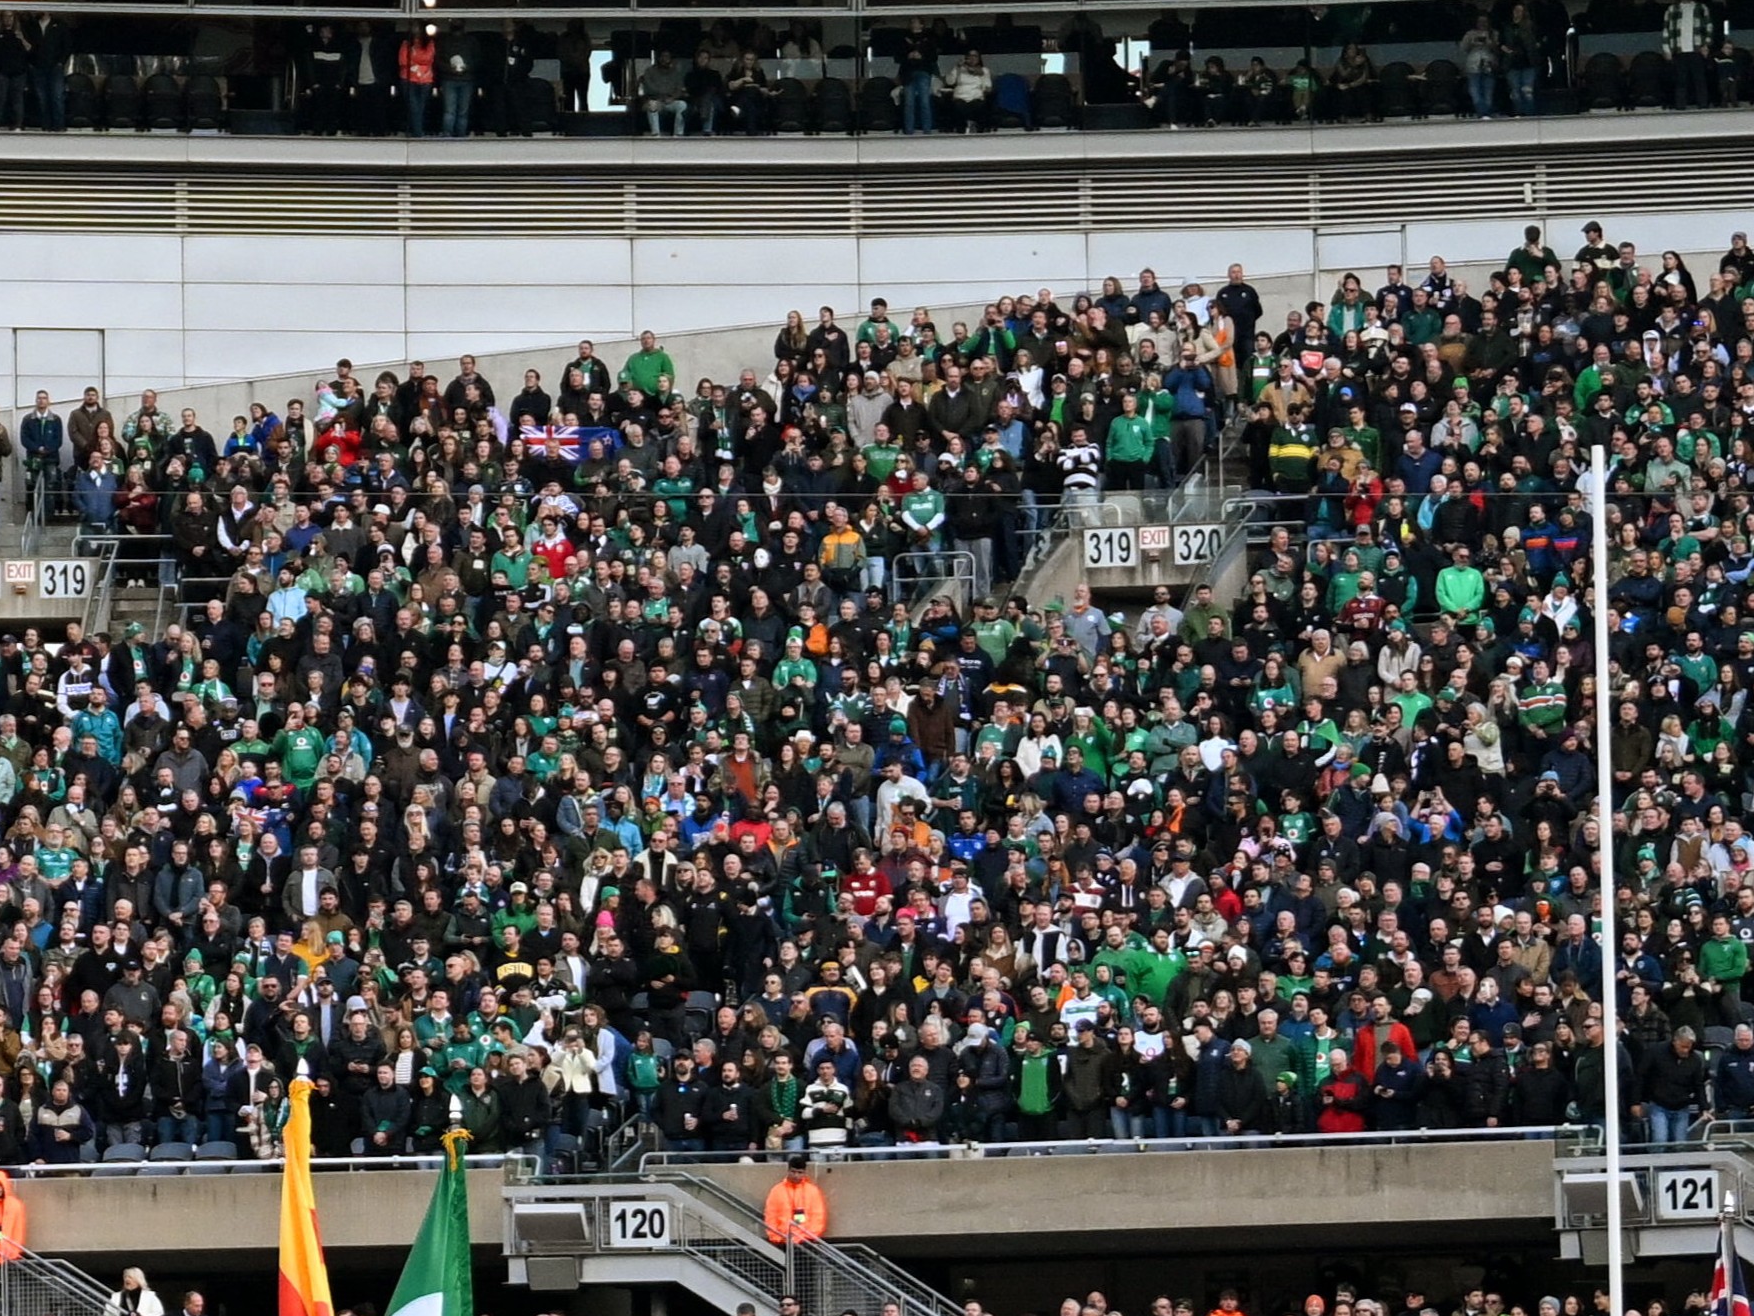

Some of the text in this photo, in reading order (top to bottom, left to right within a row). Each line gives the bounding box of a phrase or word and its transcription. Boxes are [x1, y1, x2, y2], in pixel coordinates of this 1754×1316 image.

[1090, 531, 1132, 564] 319
[1141, 529, 1167, 546] EXIT
[1180, 529, 1221, 561] 320
[7, 564, 34, 581] EXIT
[45, 564, 86, 596] 319
[1666, 1177, 1714, 1210] 121
[615, 1208, 666, 1239] 120
